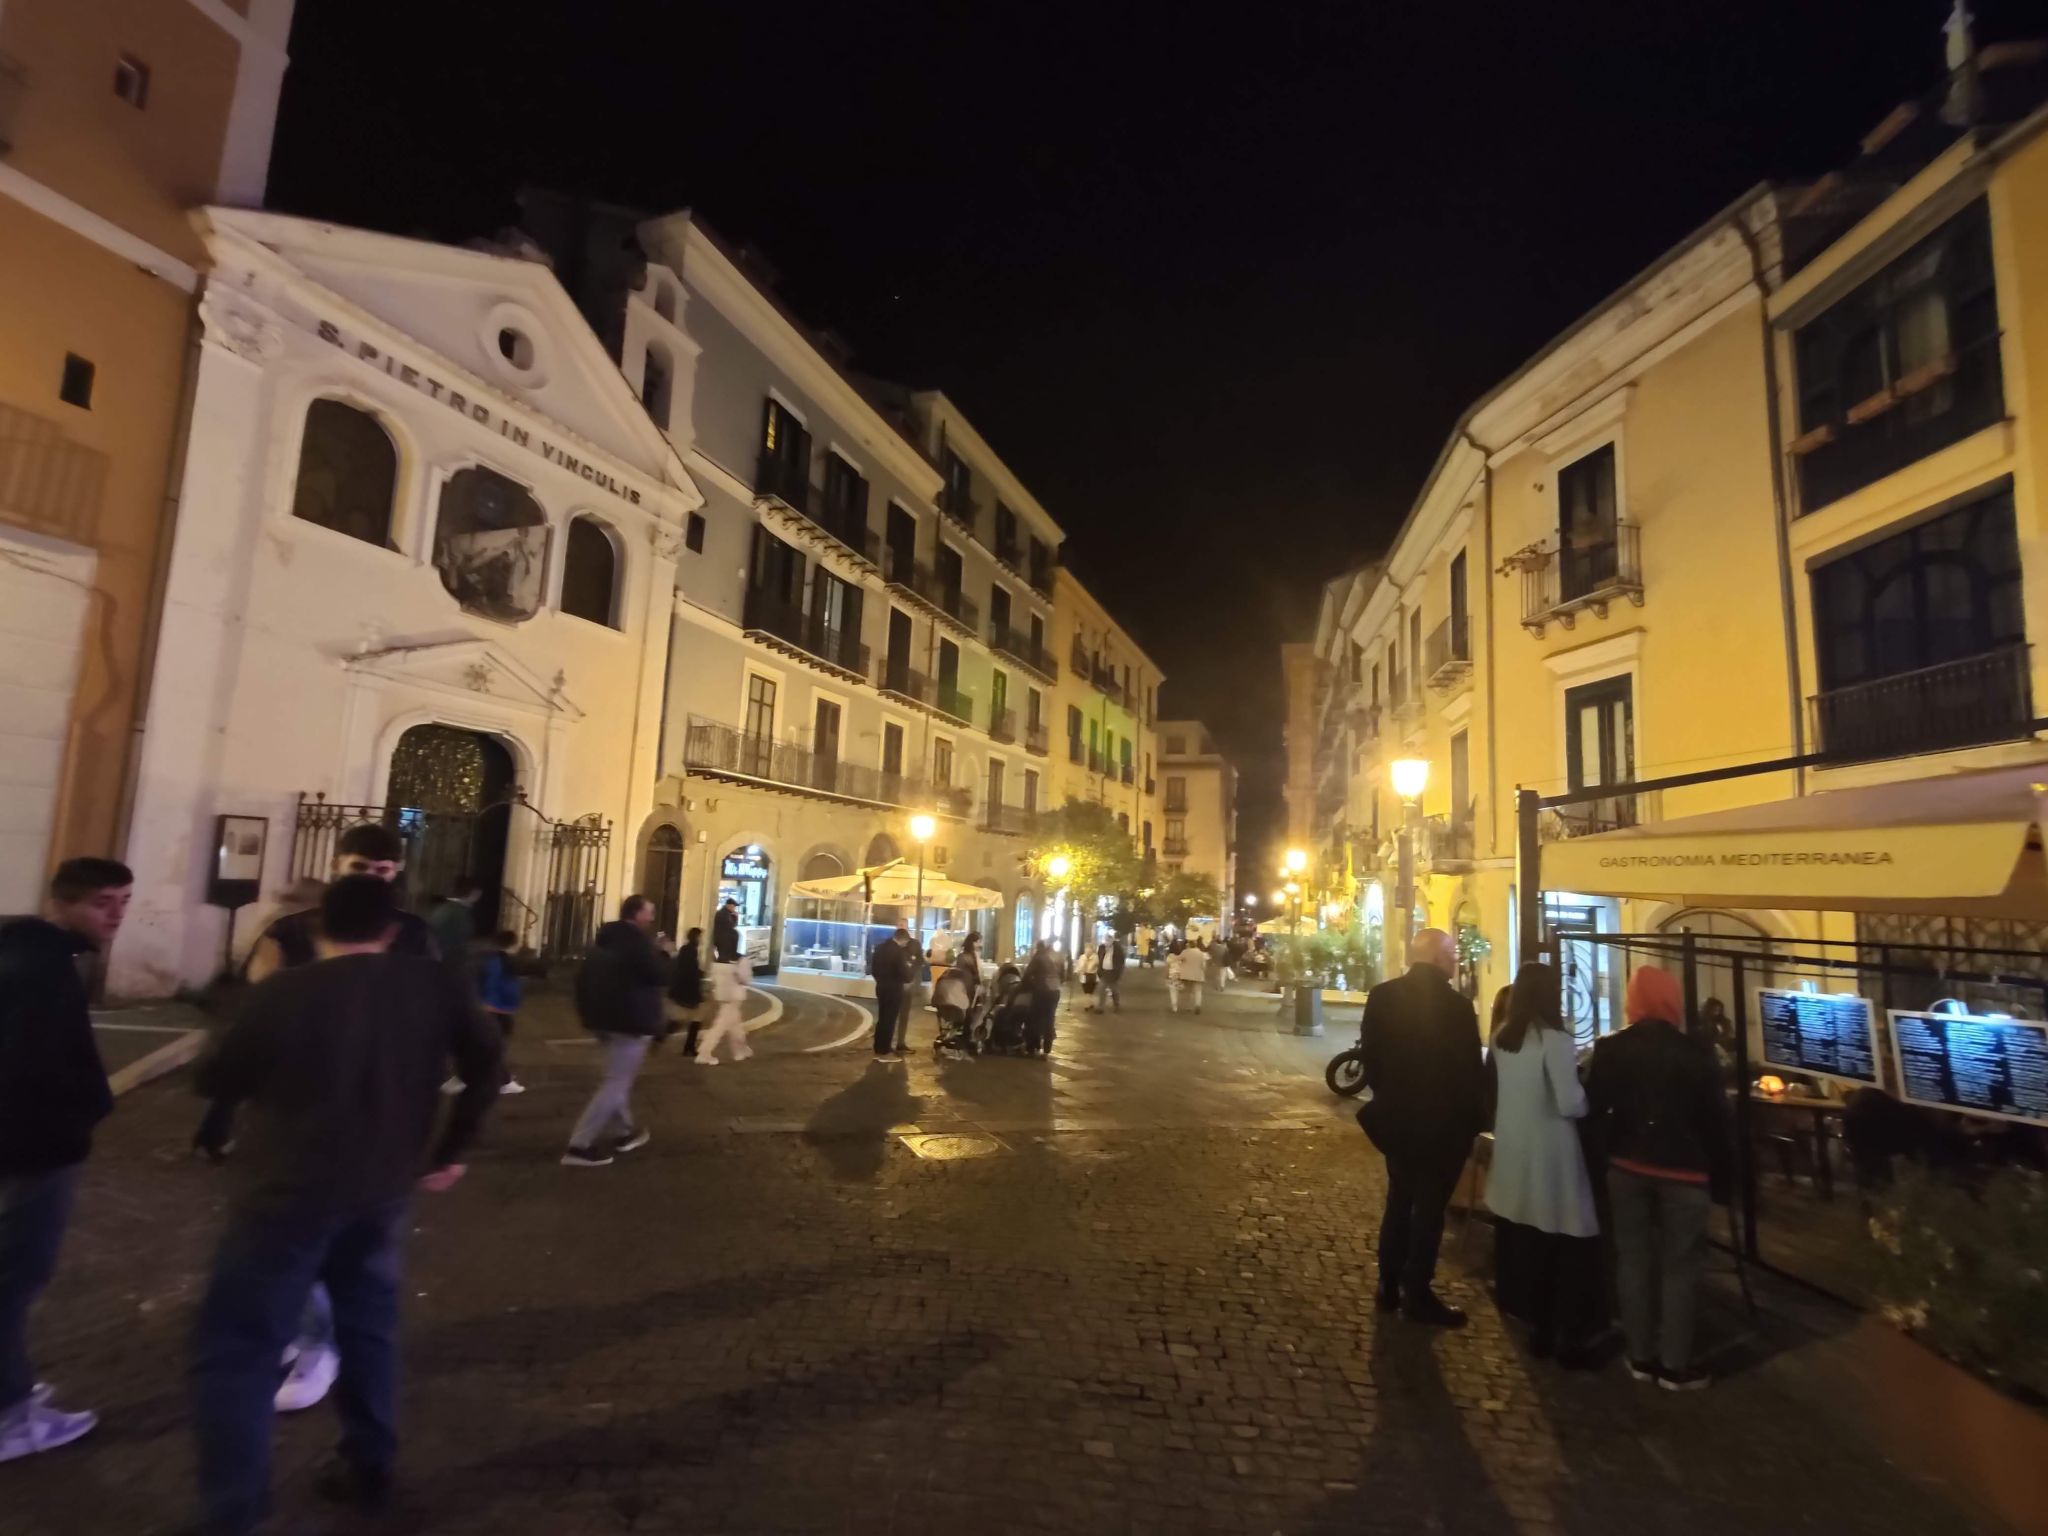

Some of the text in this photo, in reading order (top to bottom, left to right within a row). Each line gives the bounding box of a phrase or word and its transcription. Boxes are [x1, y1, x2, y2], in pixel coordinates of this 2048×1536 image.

[318, 320, 641, 505] S. PIETRO IN VINCULIS
[1600, 851, 1893, 868] GASTRONOMIA MEDITERRANEA
